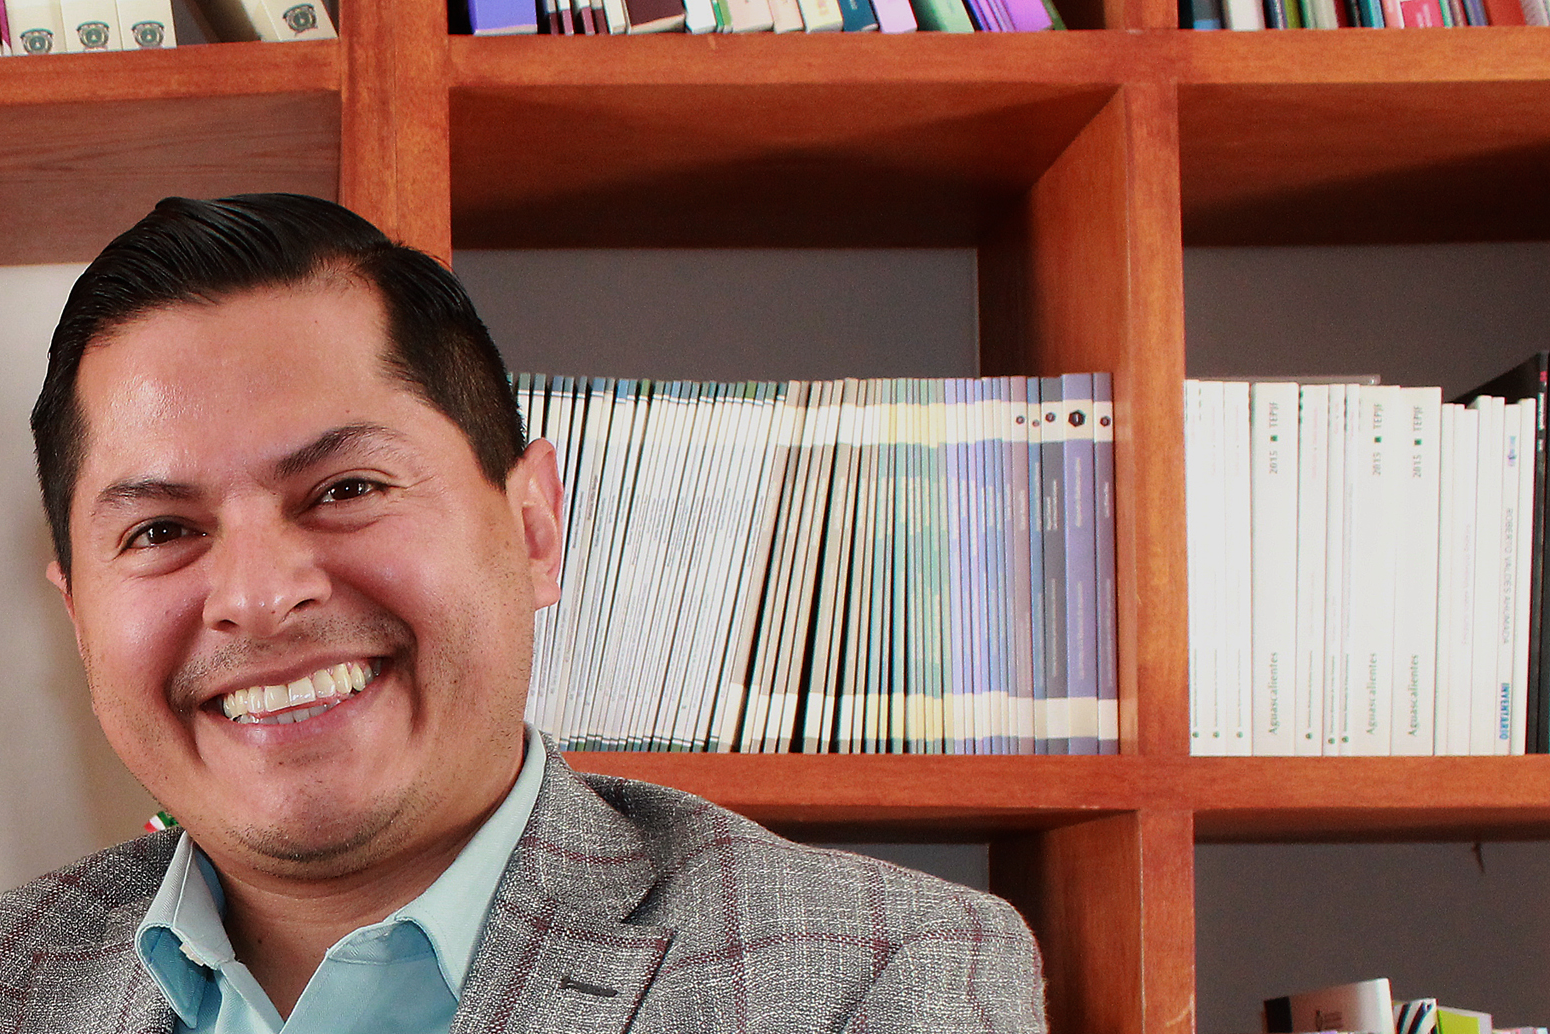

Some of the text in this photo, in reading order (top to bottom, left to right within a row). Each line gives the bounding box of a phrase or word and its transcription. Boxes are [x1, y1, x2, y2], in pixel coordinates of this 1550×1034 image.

[1270, 449, 1278, 473] 2015
[1503, 507, 1513, 553] ROBERTO
[1366, 652, 1379, 734] Aguascalientes
[1373, 451, 1381, 475] 2015
[1407, 654, 1419, 736] Aguascalientes
[1413, 454, 1421, 477] 2015
[1501, 595, 1510, 644] AHUMADA
[1268, 651, 1279, 734] Aguascalientes
[1499, 682, 1510, 740] INVENTARIO
